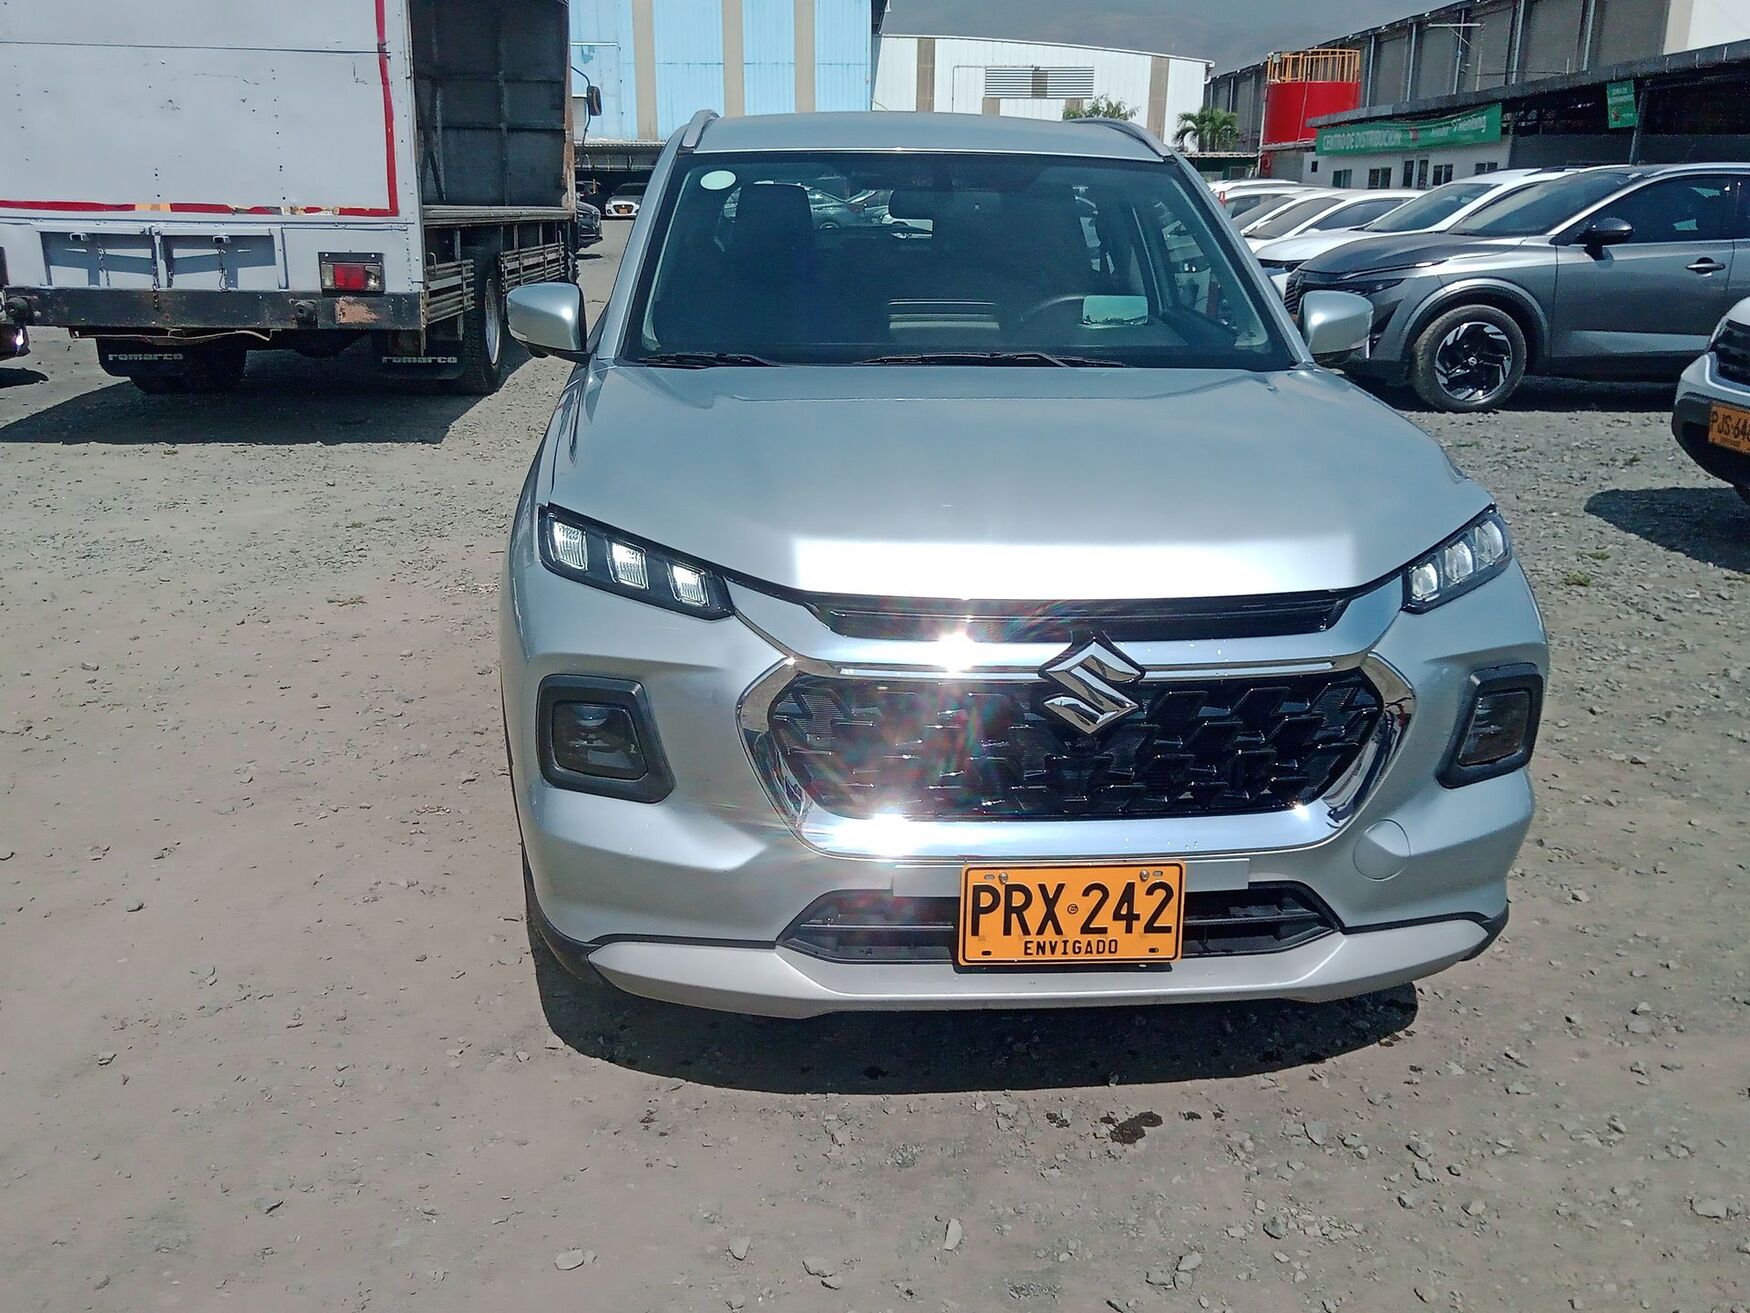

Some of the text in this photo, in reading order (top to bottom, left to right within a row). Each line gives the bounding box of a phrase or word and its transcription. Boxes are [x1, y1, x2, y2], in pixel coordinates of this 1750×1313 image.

[970, 881, 1175, 937] PRX 242
[1023, 938, 1119, 956] ENVIGADO
